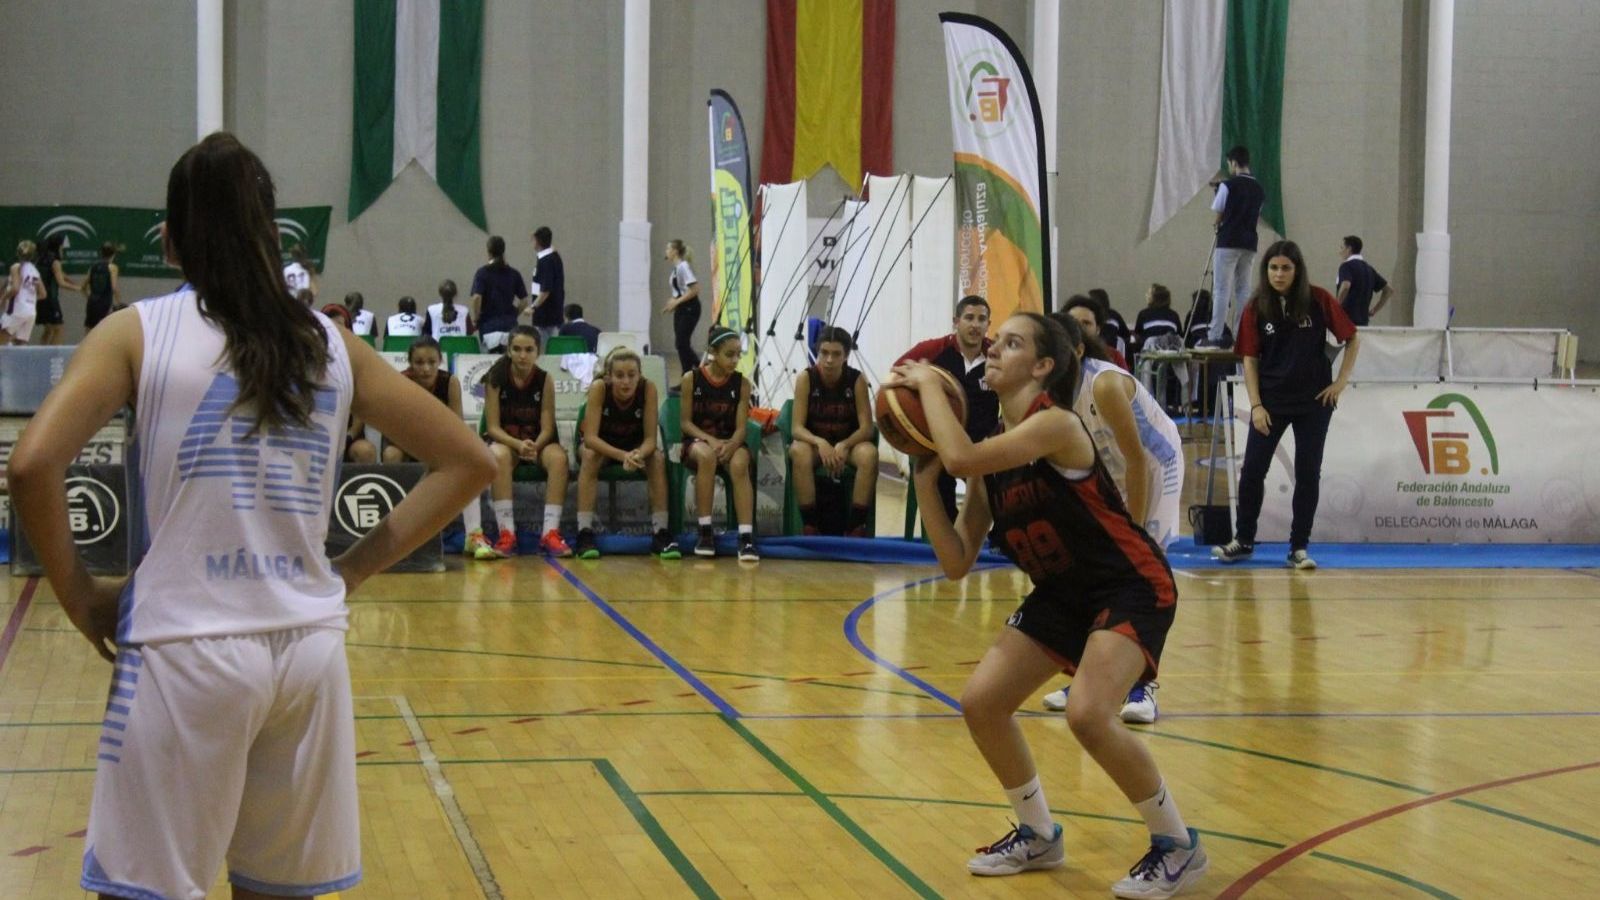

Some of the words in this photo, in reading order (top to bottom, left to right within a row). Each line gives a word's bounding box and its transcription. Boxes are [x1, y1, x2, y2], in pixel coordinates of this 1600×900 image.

[1396, 481, 1458, 494] Federación
[1460, 482, 1511, 494] Andaluza
[1416, 495, 1430, 507] de
[1433, 495, 1494, 508] Baloncesto
[1375, 515, 1462, 529] DELEGACIÓN
[1465, 517, 1480, 528] de
[1483, 514, 1538, 529] MÁLAGA
